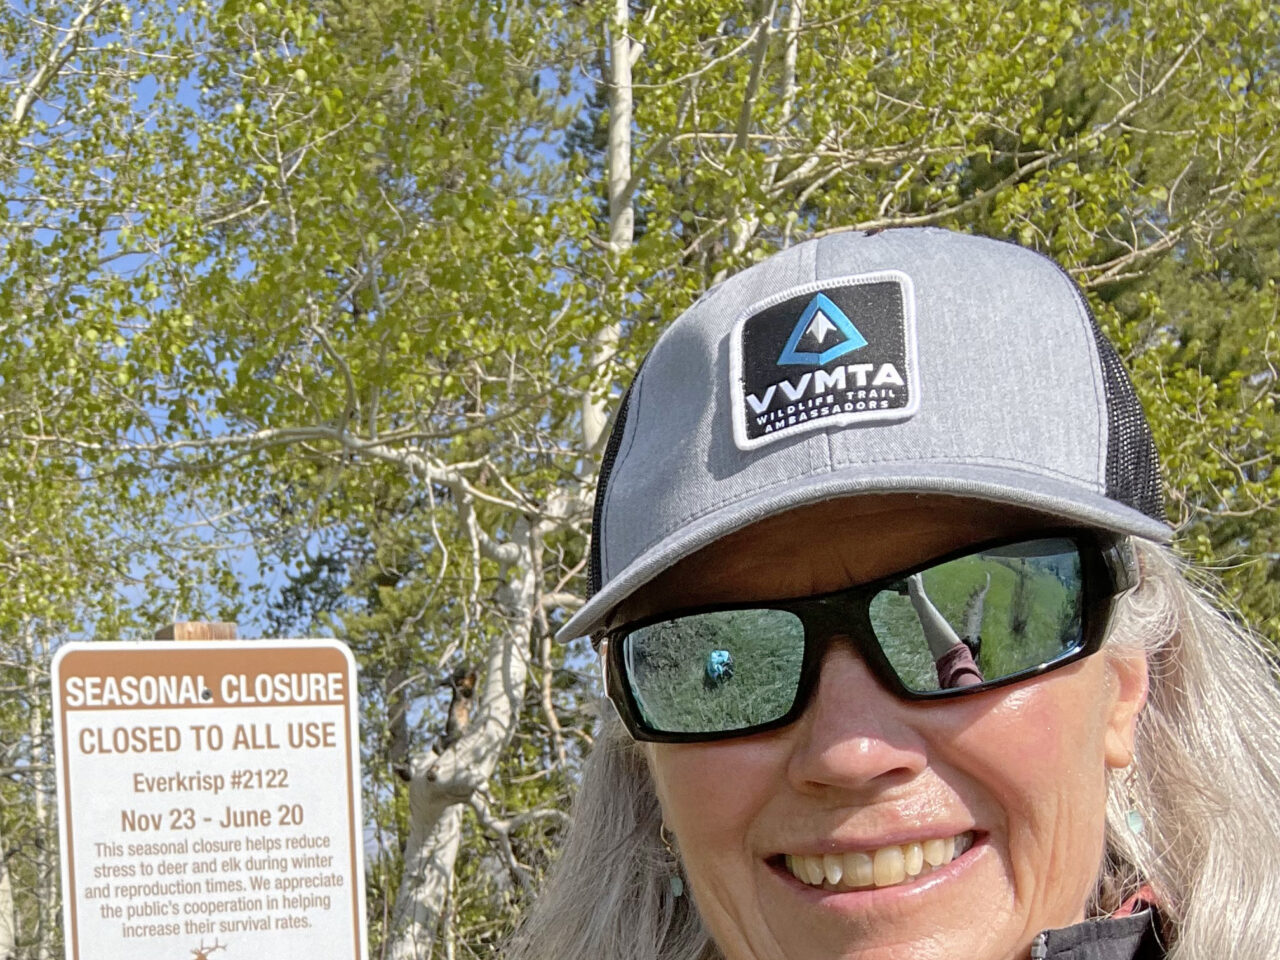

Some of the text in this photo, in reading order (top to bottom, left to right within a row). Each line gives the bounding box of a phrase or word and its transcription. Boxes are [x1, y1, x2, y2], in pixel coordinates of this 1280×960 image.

[746, 363, 905, 414] VVMTA
[756, 389, 895, 425] WILDLIFE TRAIL
[765, 400, 889, 433] AMBASSADORS
[66, 673, 344, 706] SEASONAL CLOSURE
[79, 722, 336, 755] CLOSED TO ALL USE
[133, 768, 289, 794] Everkrisp #2122
[121, 810, 162, 832] Nov
[169, 808, 196, 830] 23
[220, 806, 271, 828] June
[278, 804, 304, 826] 20
[94, 834, 330, 857] This seasonal closure helps reduce
[94, 853, 333, 878] stress to deer and elk during winter
[85, 873, 344, 900] and reproduction times. We appreciate
[100, 893, 331, 920] the public's cooperation in helping
[122, 914, 312, 938] increase their survival rates.
